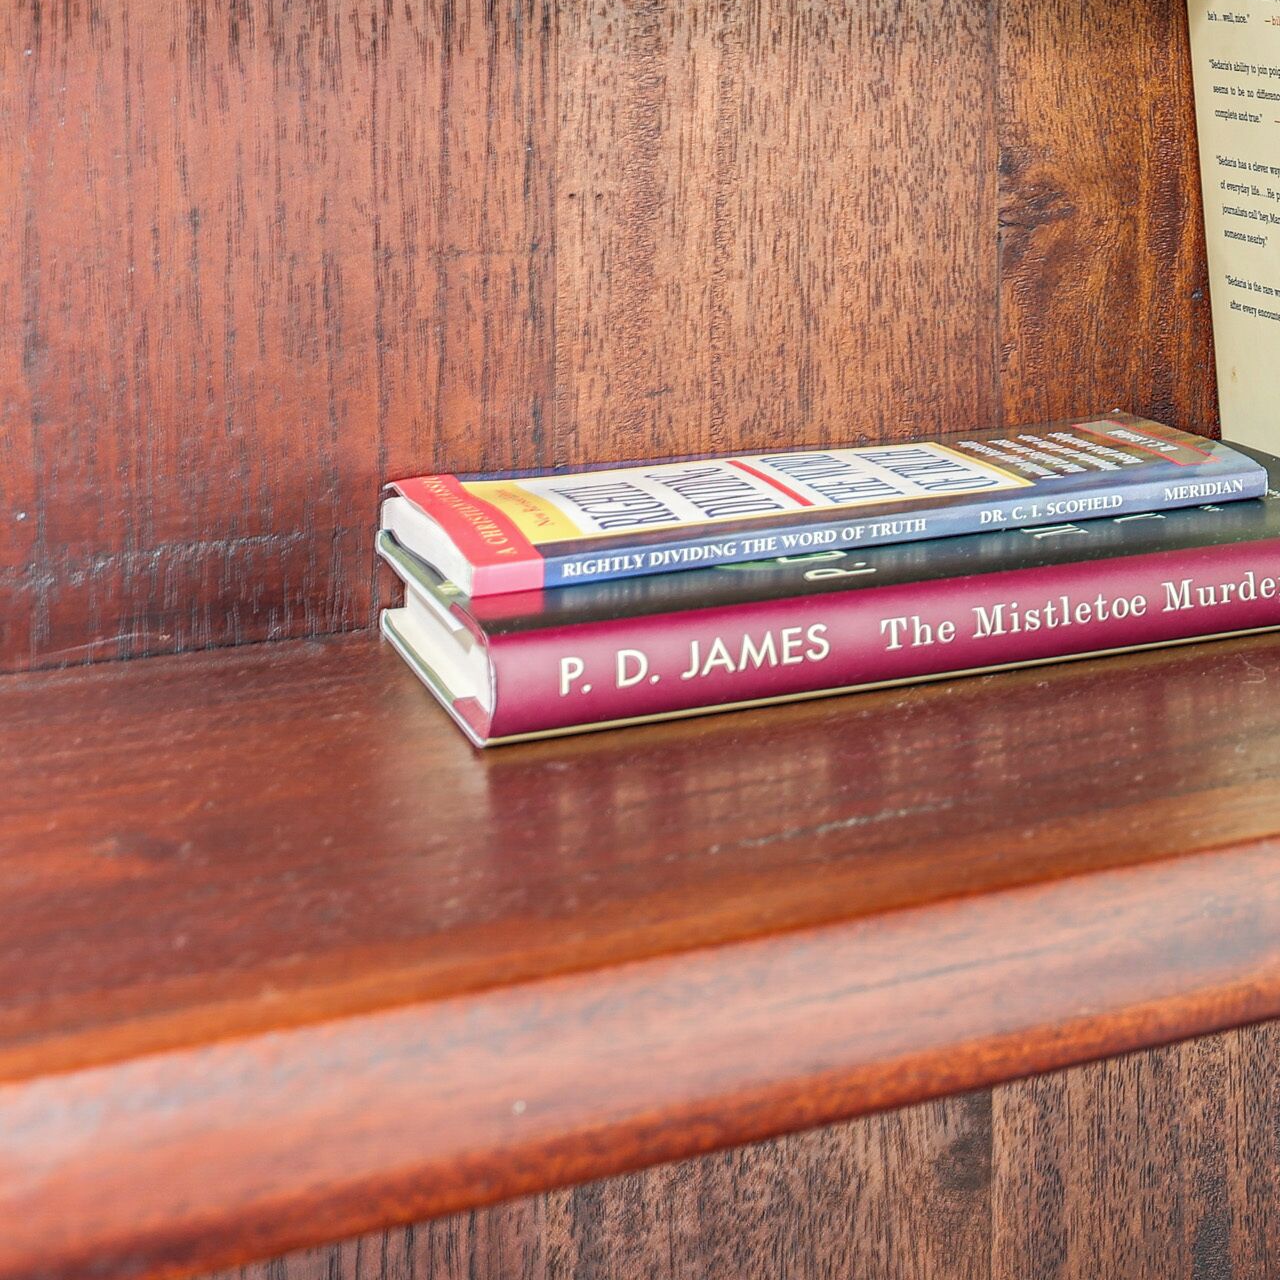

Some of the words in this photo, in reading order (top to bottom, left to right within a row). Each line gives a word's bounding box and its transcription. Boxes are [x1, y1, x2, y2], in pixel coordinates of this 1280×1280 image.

[980, 504, 1005, 524] DR.
[1010, 503, 1028, 521] C.
[1046, 494, 1123, 517] SCOFIELD
[1164, 478, 1244, 501] MERIDIAN
[562, 551, 645, 577] RIGHTLY
[648, 540, 737, 568] DIVIDING
[743, 535, 777, 554] THE
[780, 525, 837, 549] WORD
[841, 523, 864, 541] OF
[868, 517, 927, 538] TRUTH
[560, 658, 592, 695] P.
[616, 649, 659, 686] D.
[680, 623, 830, 680] JAMES
[880, 608, 956, 651] The
[971, 591, 1147, 638] Mistletoe
